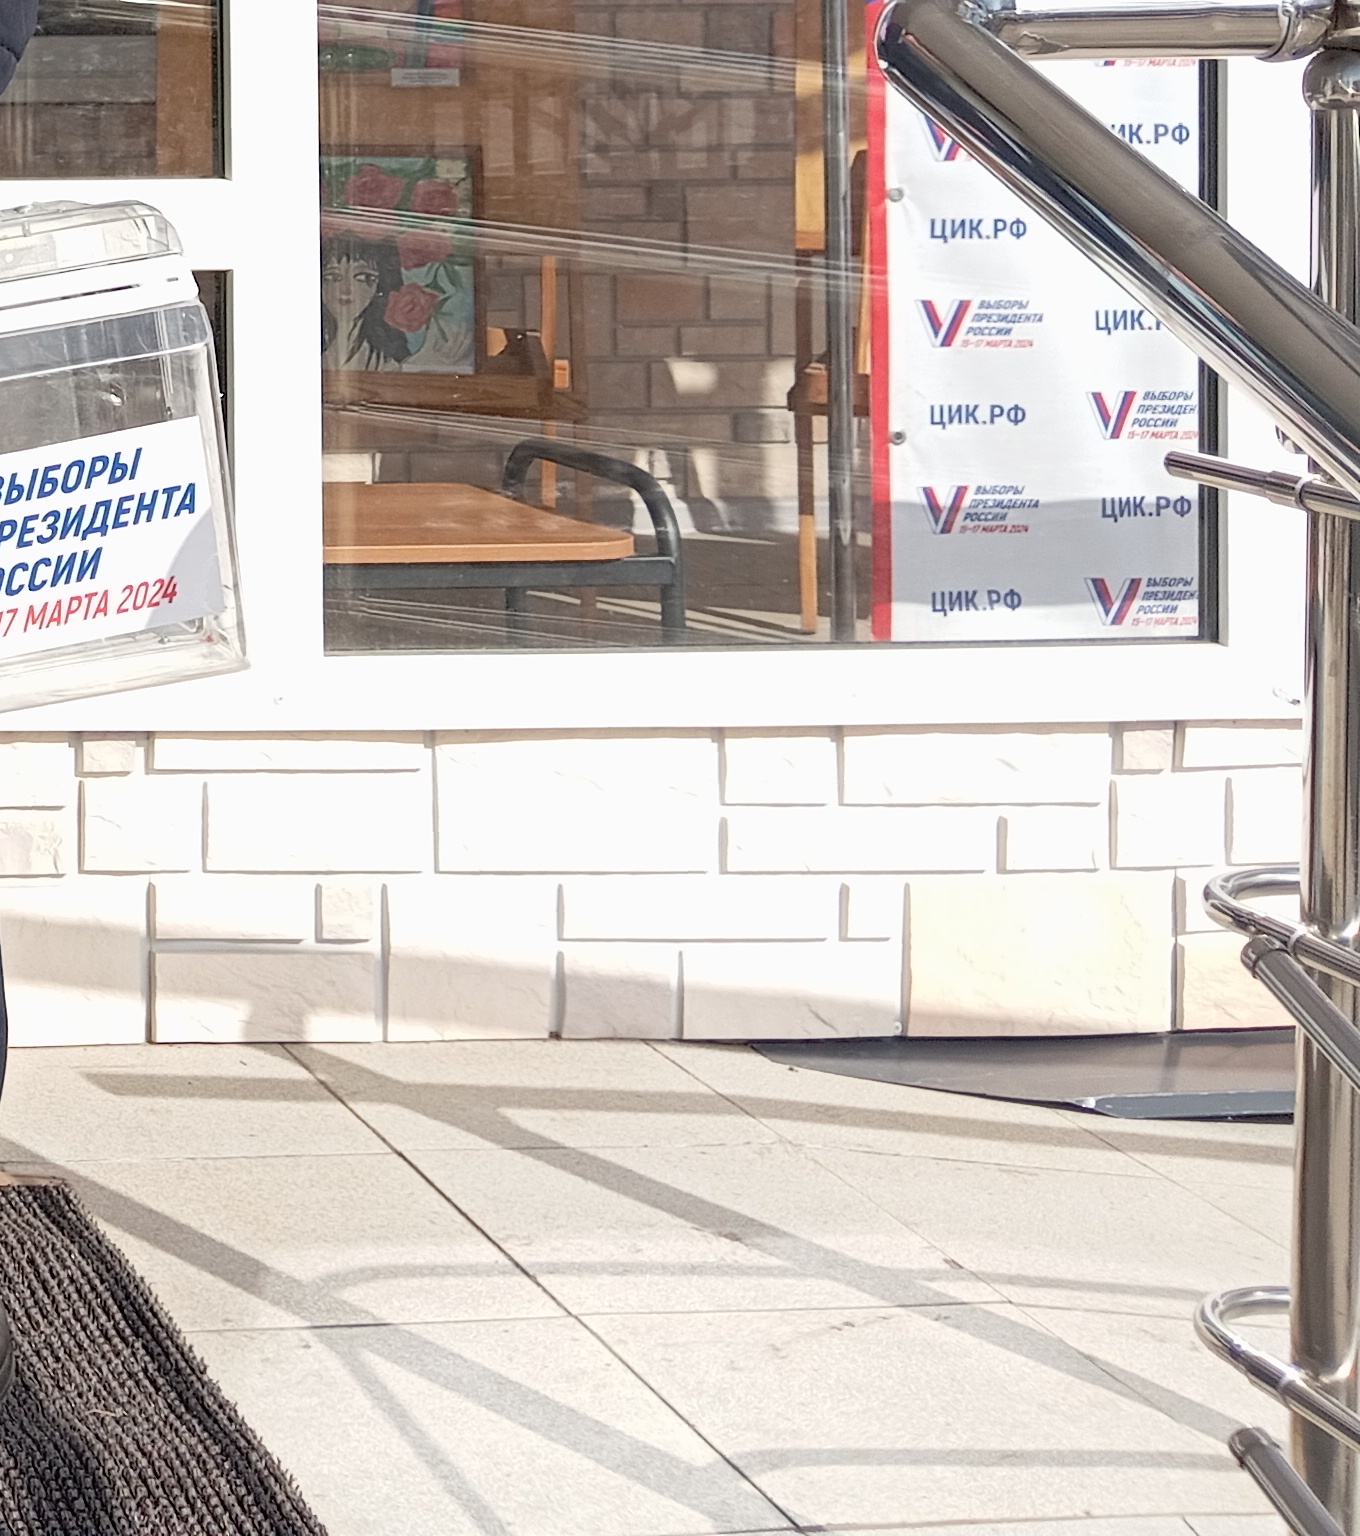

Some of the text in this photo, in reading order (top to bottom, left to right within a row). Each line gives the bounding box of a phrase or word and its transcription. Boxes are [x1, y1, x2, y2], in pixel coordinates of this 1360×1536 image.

[930, 217, 1028, 243] ЦИК.РФ
[977, 299, 1030, 310] ВЫБОРЫ
[971, 312, 1044, 324] ПРЕЗИДЕНТА
[1095, 309, 1163, 336] ЦИК.
[965, 326, 1013, 336] РОССИИ
[1142, 390, 1194, 401] ВЫБОРЫ
[1136, 404, 1198, 415] ПРЕЗИДЕН
[930, 403, 1026, 430] ЦИК.РФ
[1131, 417, 1180, 428] РОССИИ
[974, 485, 1026, 496] ВЫБОРЫ
[968, 498, 1040, 510] ПРЕЗИДЕНТА
[1101, 495, 1192, 523] ЦИК.РФ
[962, 511, 1008, 522] РОССИИ
[1146, 577, 1194, 588] ВЫБОРЫ
[23, 588, 109, 633] МАРТА
[116, 575, 179, 615] 2024
[931, 588, 1023, 617] ЦИК.РФ
[1136, 604, 1179, 615] РОССИИ
